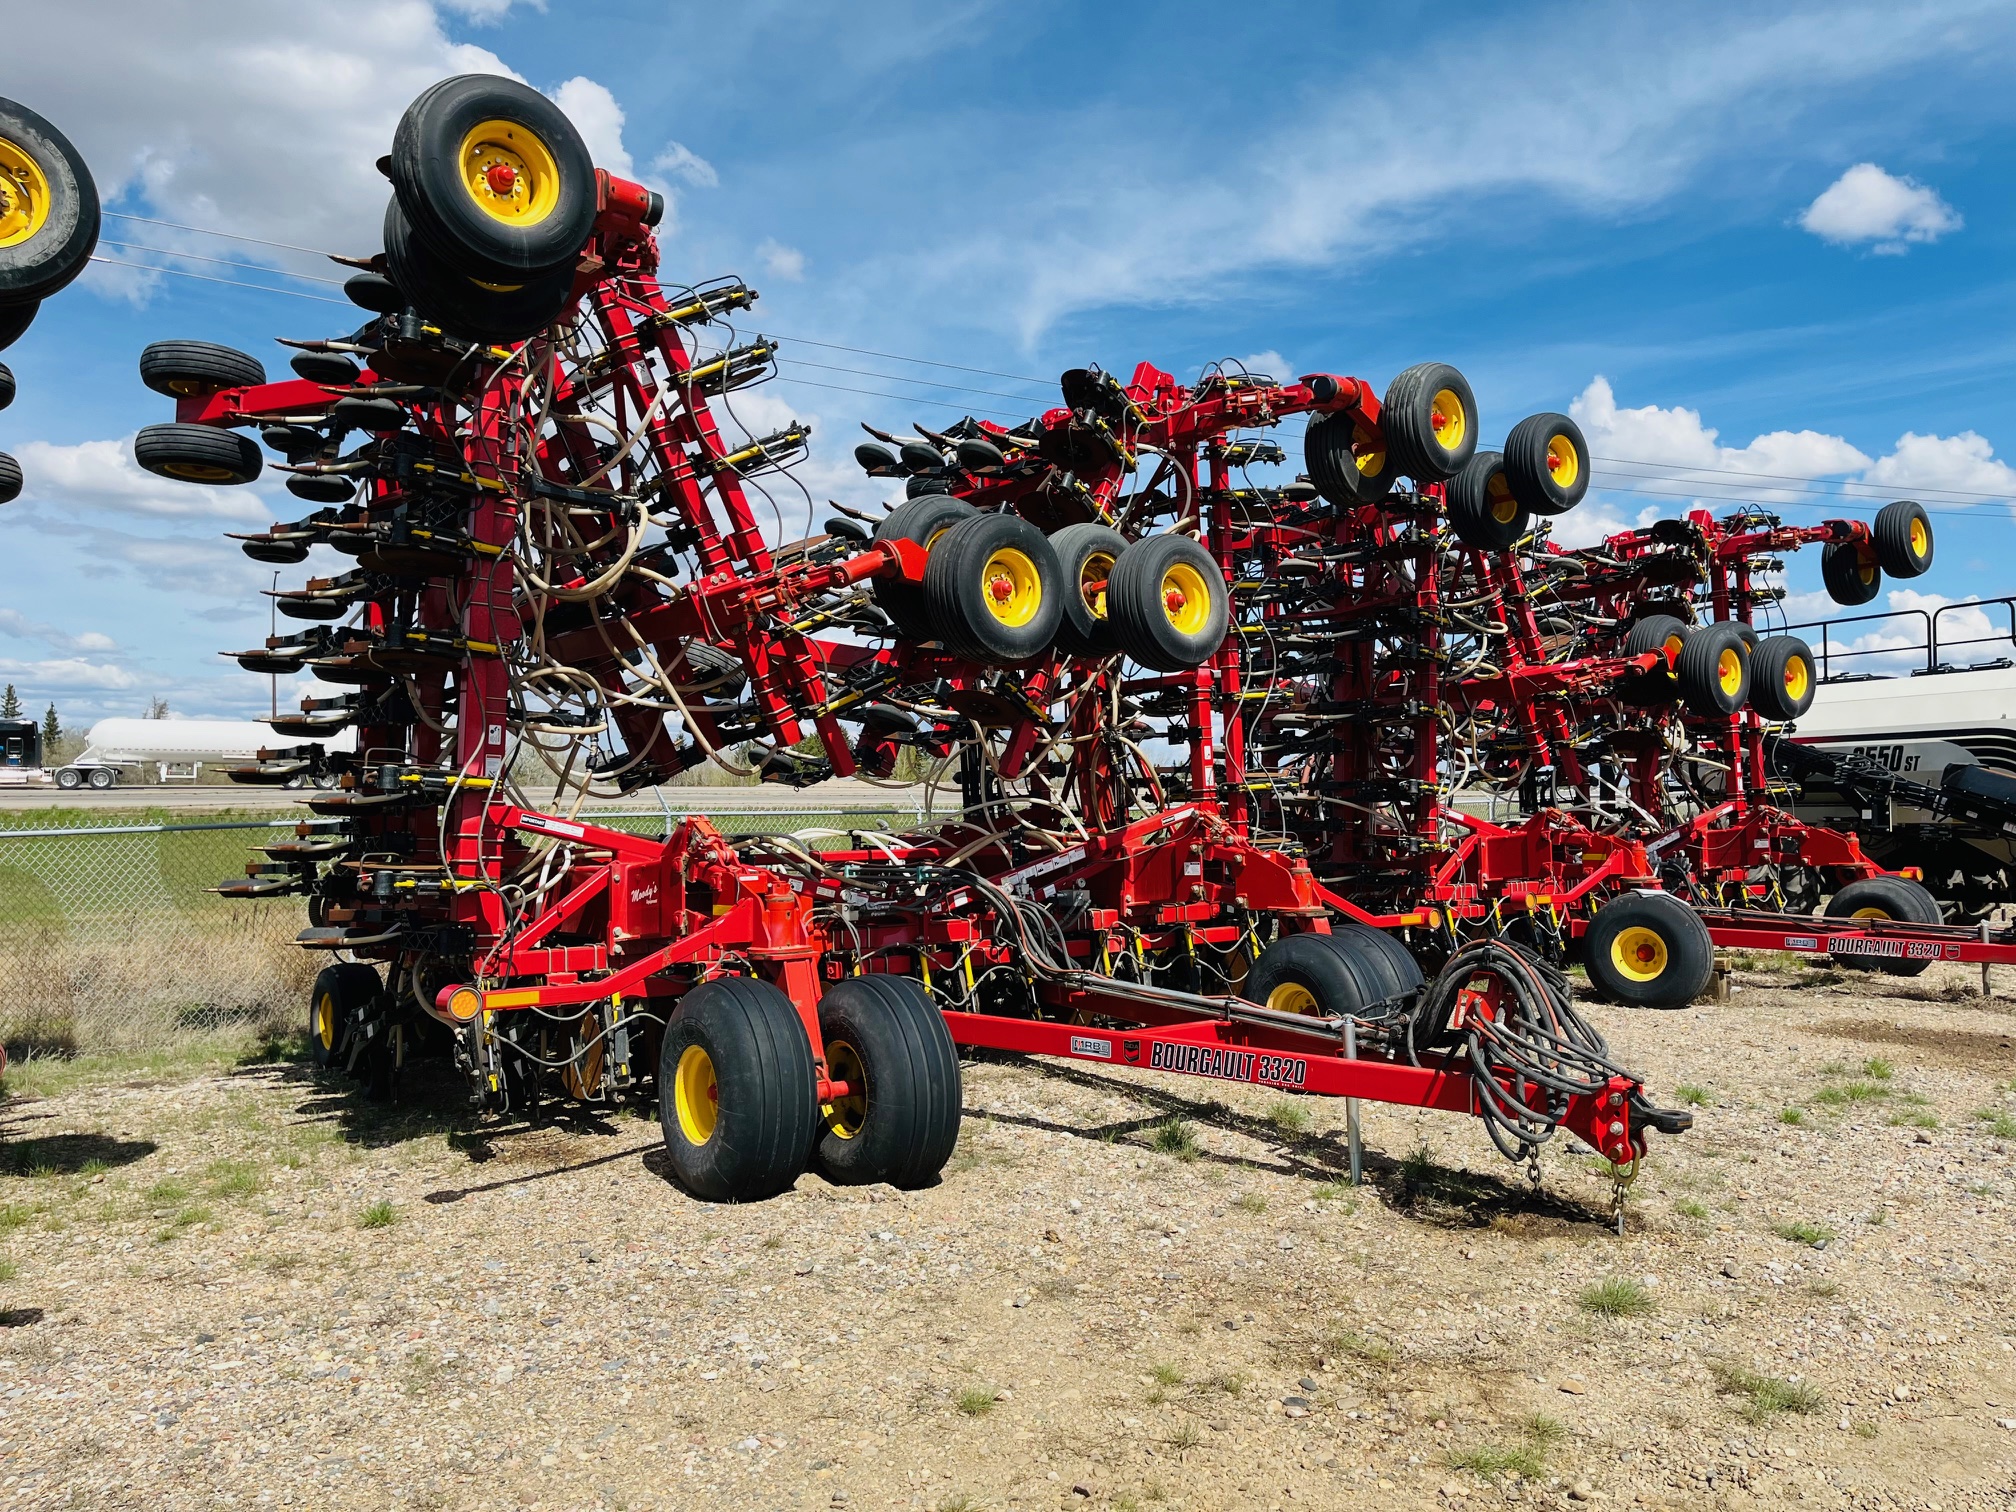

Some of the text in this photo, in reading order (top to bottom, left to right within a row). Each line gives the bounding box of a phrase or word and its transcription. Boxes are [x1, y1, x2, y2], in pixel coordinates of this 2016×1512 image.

[1904, 755, 1921, 772] ST
[630, 881, 658, 903] Moody's
[1827, 937, 1905, 958] BOURGAULT
[1907, 941, 1942, 958] 3320
[1150, 1041, 1307, 1084] BOURGAULT 3320
